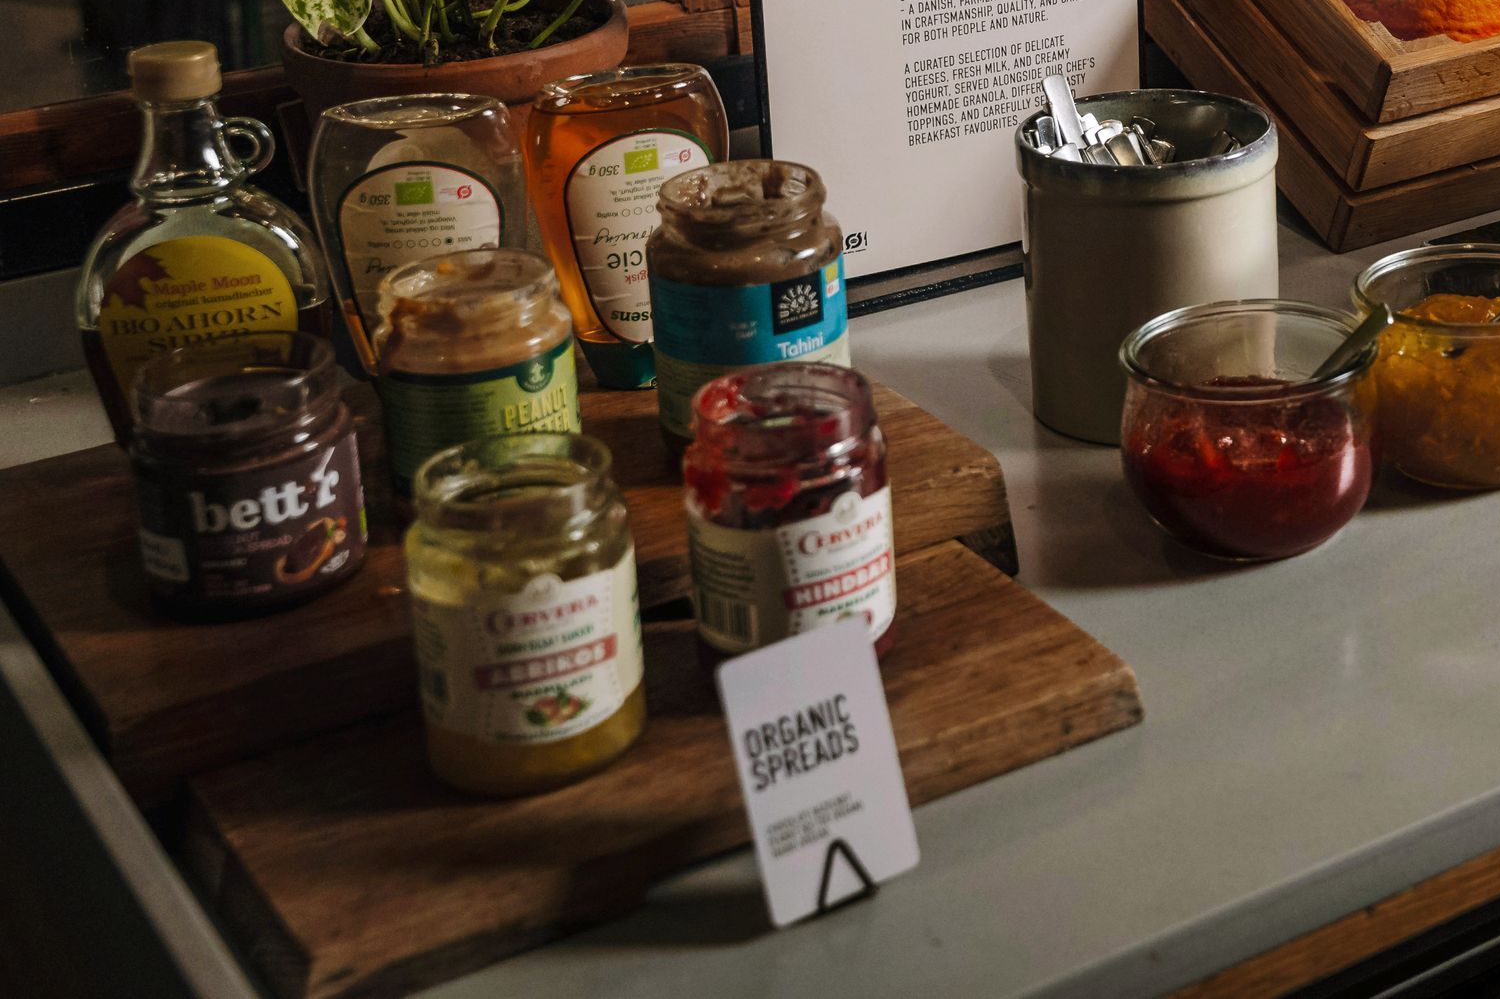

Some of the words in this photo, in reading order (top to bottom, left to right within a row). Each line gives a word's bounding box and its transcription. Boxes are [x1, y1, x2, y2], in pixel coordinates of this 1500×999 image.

[902, 19, 911, 31] IN
[915, 5, 993, 28] CRAFTSMANSHIP,
[909, 4, 914, 15] A
[902, 32, 920, 45] FOR
[924, 27, 948, 42] BOTH
[952, 21, 986, 37] PEOPLE
[990, 17, 1008, 30] AND
[1012, 10, 1048, 26] NATURE.
[904, 64, 910, 74] A
[914, 56, 954, 72] CURATED
[959, 46, 1007, 64] SELECTION
[1011, 43, 1022, 55] OF
[1025, 35, 1064, 52] DELICATE
[905, 71, 948, 89] CHEESES,
[953, 65, 981, 80] FRESH
[985, 60, 1010, 74] MILK,
[1014, 56, 1031, 69] AND
[1035, 48, 1070, 65] CREAMY
[906, 85, 951, 103] YOGHURT,
[955, 78, 988, 94] SERVED
[993, 68, 1042, 87] ALONGSIDE
[1046, 64, 1063, 76] OUR
[907, 98, 960, 118] HOMEMADE
[963, 89, 1008, 107] GRANOLA,
[1066, 73, 1086, 87] ASTY
[908, 113, 957, 132] TOPPINGS,
[961, 108, 979, 122] AND
[983, 98, 1031, 117] CAREFULLY
[909, 126, 960, 146] BREAKFAST
[599, 164, 619, 177] 350
[153, 280, 206, 296] Maple
[212, 273, 261, 289] Moon
[778, 332, 823, 358] Tahini
[502, 386, 567, 430] PEANUT
[743, 693, 849, 758] ORGANIC
[751, 724, 859, 791] SPREADS
